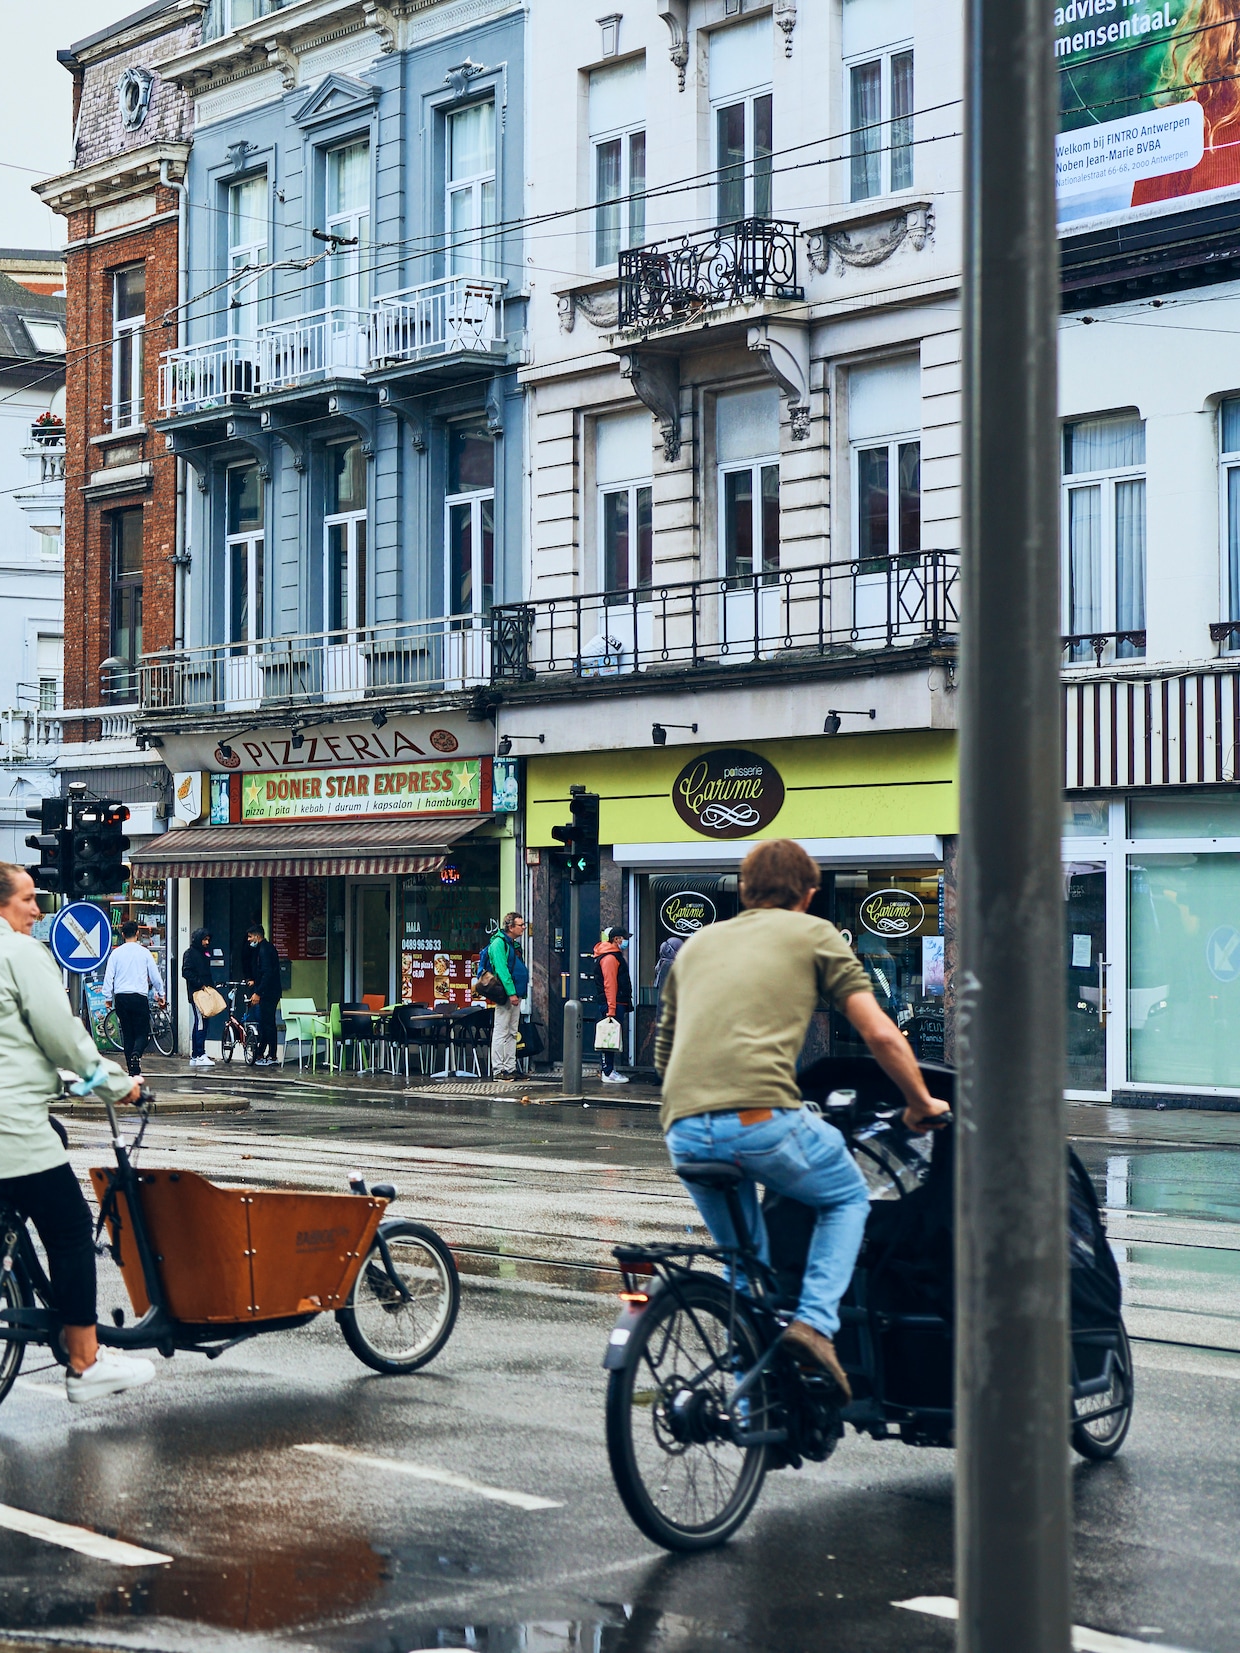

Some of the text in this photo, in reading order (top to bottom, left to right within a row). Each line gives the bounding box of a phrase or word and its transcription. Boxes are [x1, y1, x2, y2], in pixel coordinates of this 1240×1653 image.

[1054, 0, 1117, 26] advies
[1054, 2, 1178, 57] mensentaal.
[1055, 117, 1190, 158] Welkom bij FINTRO Antwerpen
[1055, 139, 1162, 174] Noben Jean-Marie BVBA
[1055, 169, 1107, 188] Nationalestraat
[1131, 158, 1150, 170] 2000
[1151, 150, 1189, 165] Antwerpen
[242, 730, 427, 767] PIZZERIA
[266, 769, 454, 801] DÖNER STAR EXPRESS
[723, 765, 763, 779] patisserie
[245, 797, 477, 817] pizza pita kebab durum kapsalon hamburger
